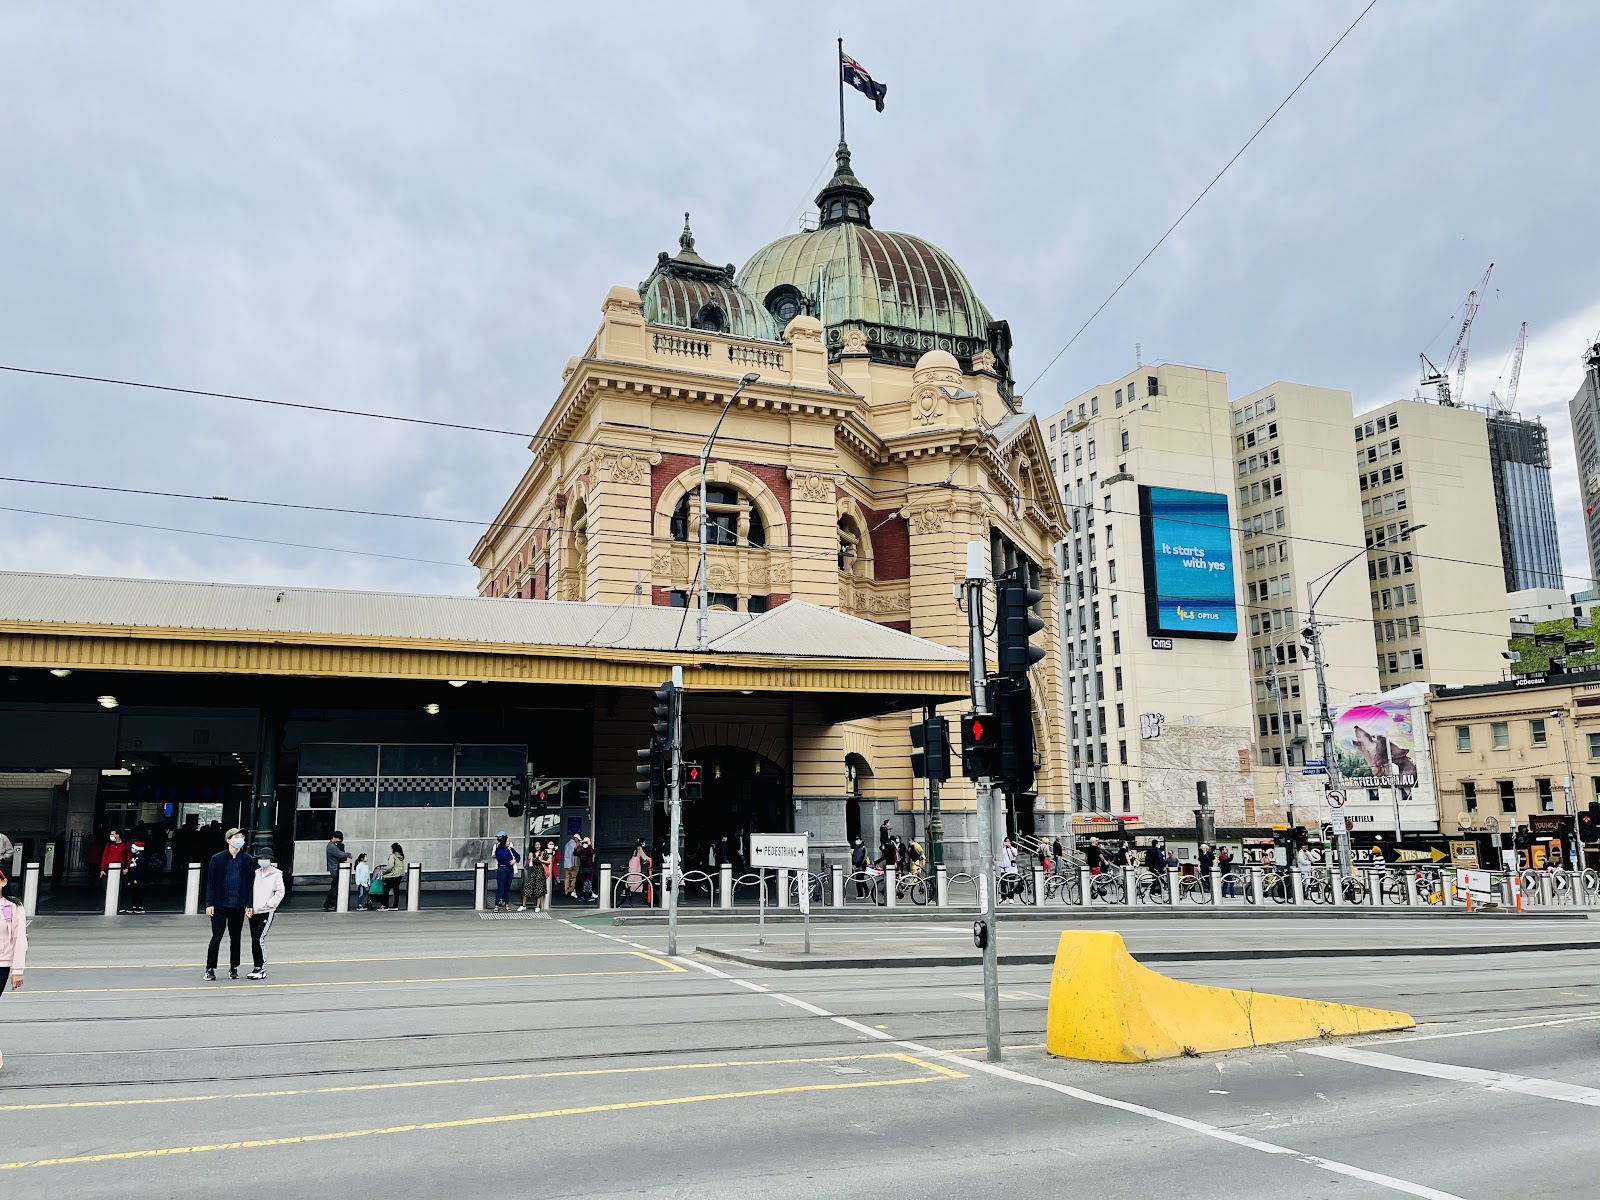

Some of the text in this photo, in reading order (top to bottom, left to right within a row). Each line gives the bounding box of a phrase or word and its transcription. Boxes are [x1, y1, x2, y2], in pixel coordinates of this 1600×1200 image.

[1162, 543, 1205, 557] It starts
[1183, 557, 1225, 571] with yes
[1197, 612, 1219, 620] OPTUS
[1516, 678, 1545, 686] JCDecaux
[764, 847, 796, 856] PEDESTRIANS
[1399, 849, 1432, 861] THIS WAY
